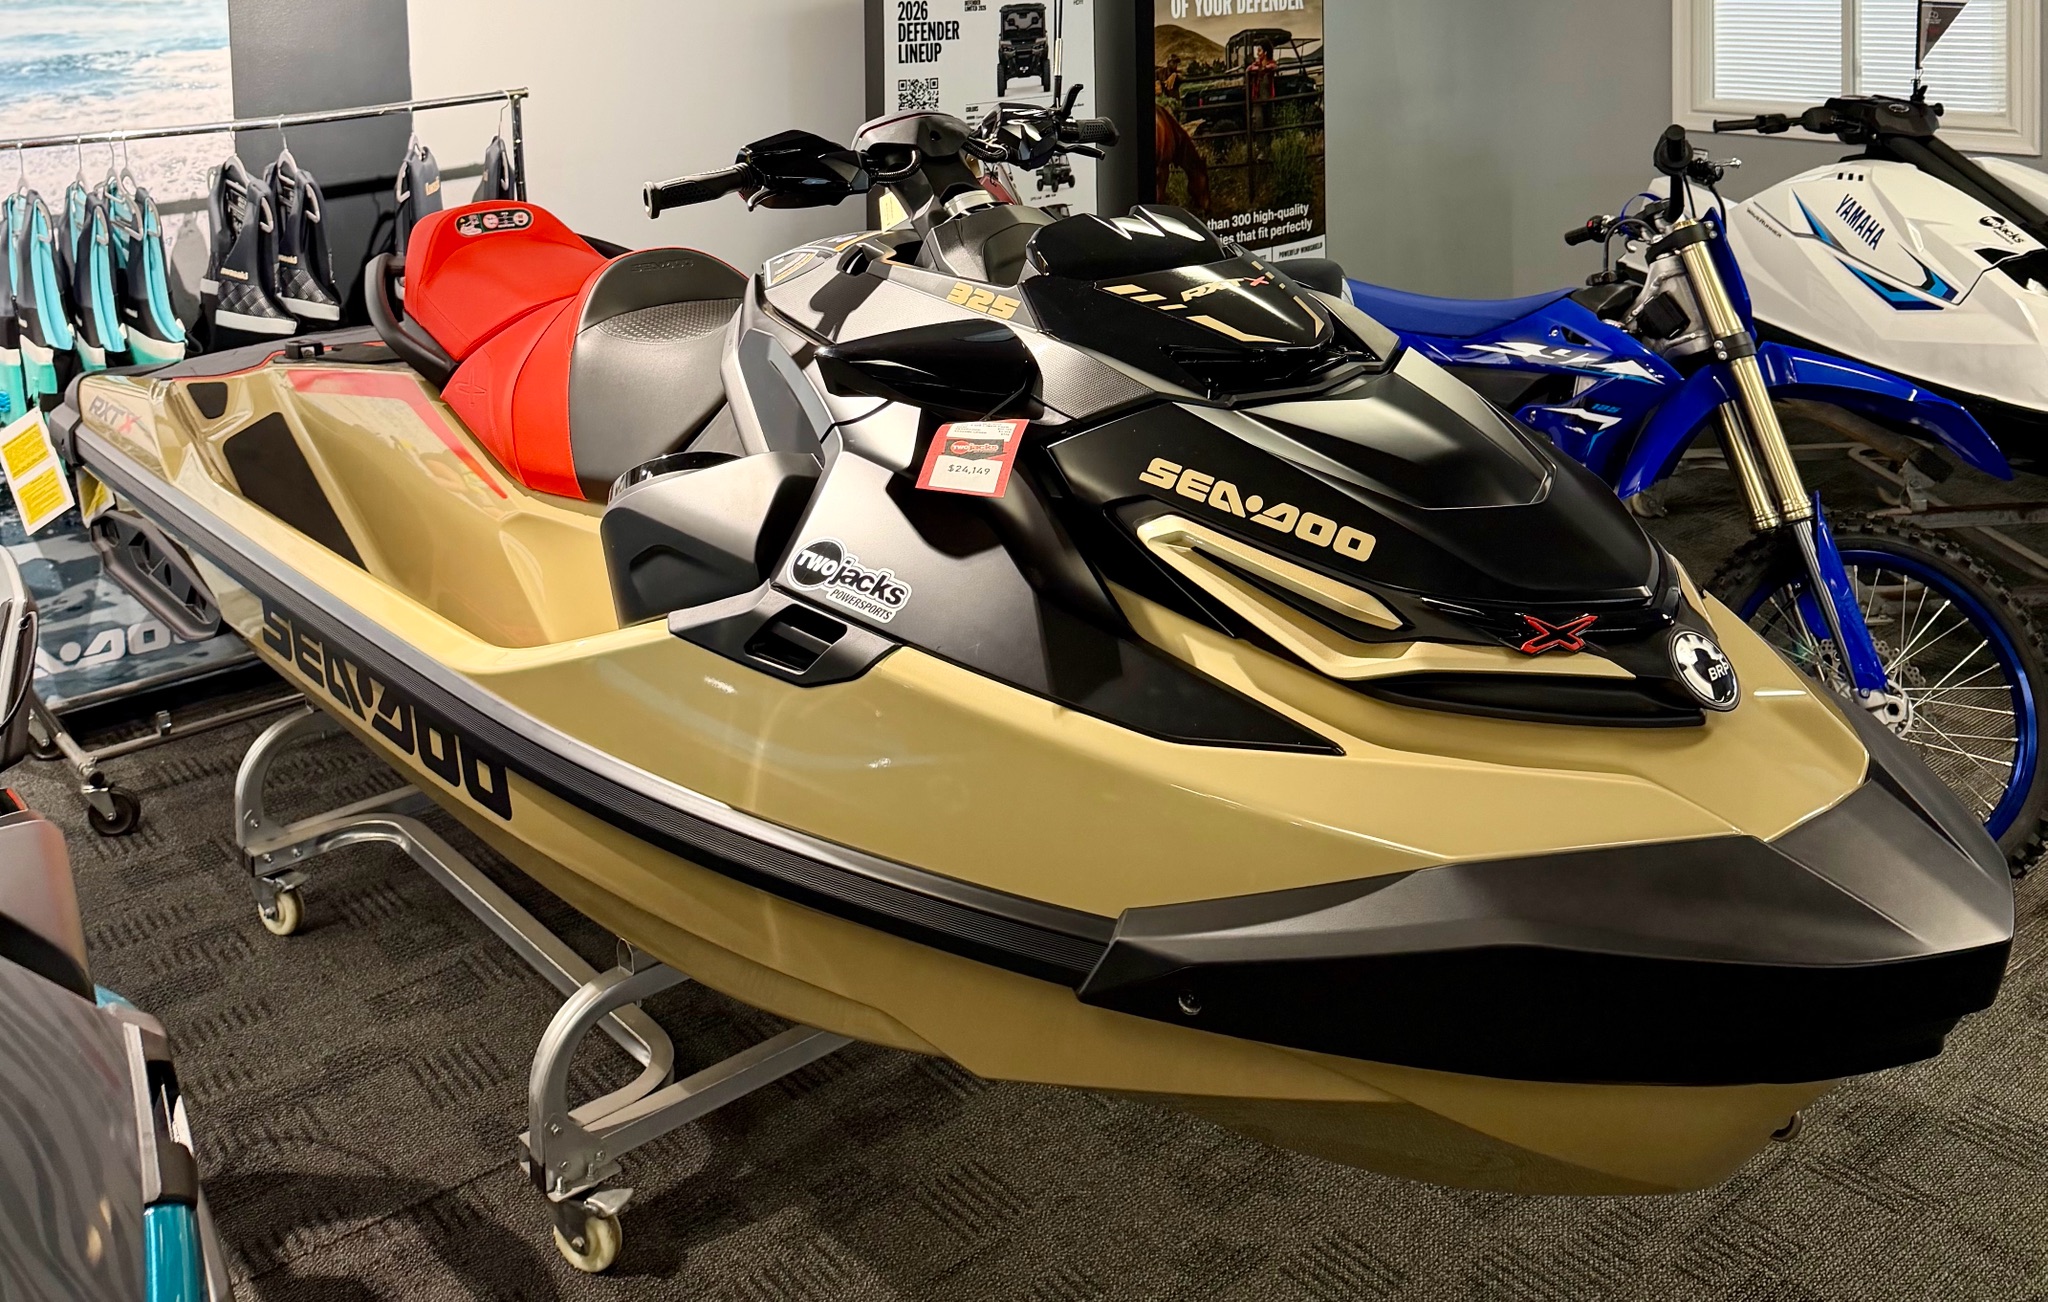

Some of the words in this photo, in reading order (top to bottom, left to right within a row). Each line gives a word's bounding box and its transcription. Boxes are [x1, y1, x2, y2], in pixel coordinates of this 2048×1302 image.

[898, 1, 928, 21] 2026
[1170, 0, 1189, 19] OF
[1195, 0, 1232, 17] YOUR
[898, 21, 960, 42] DEFENDER
[898, 43, 942, 64] LINEUP
[1207, 218, 1230, 231] than
[1231, 213, 1252, 227] 300
[1253, 203, 1310, 224] high-quality
[1835, 193, 1885, 250] YAMAHA
[1236, 230, 1256, 243] that
[1258, 226, 1269, 239] fit
[1270, 218, 1313, 239] perfectly
[946, 281, 1022, 320] 325
[89, 396, 126, 426] RXT
[947, 464, 991, 476] $24,149
[797, 549, 839, 576] TWO
[827, 559, 905, 605] jacks
[830, 588, 893, 621] POWERSPORTS
[1708, 660, 1730, 682] BRP
